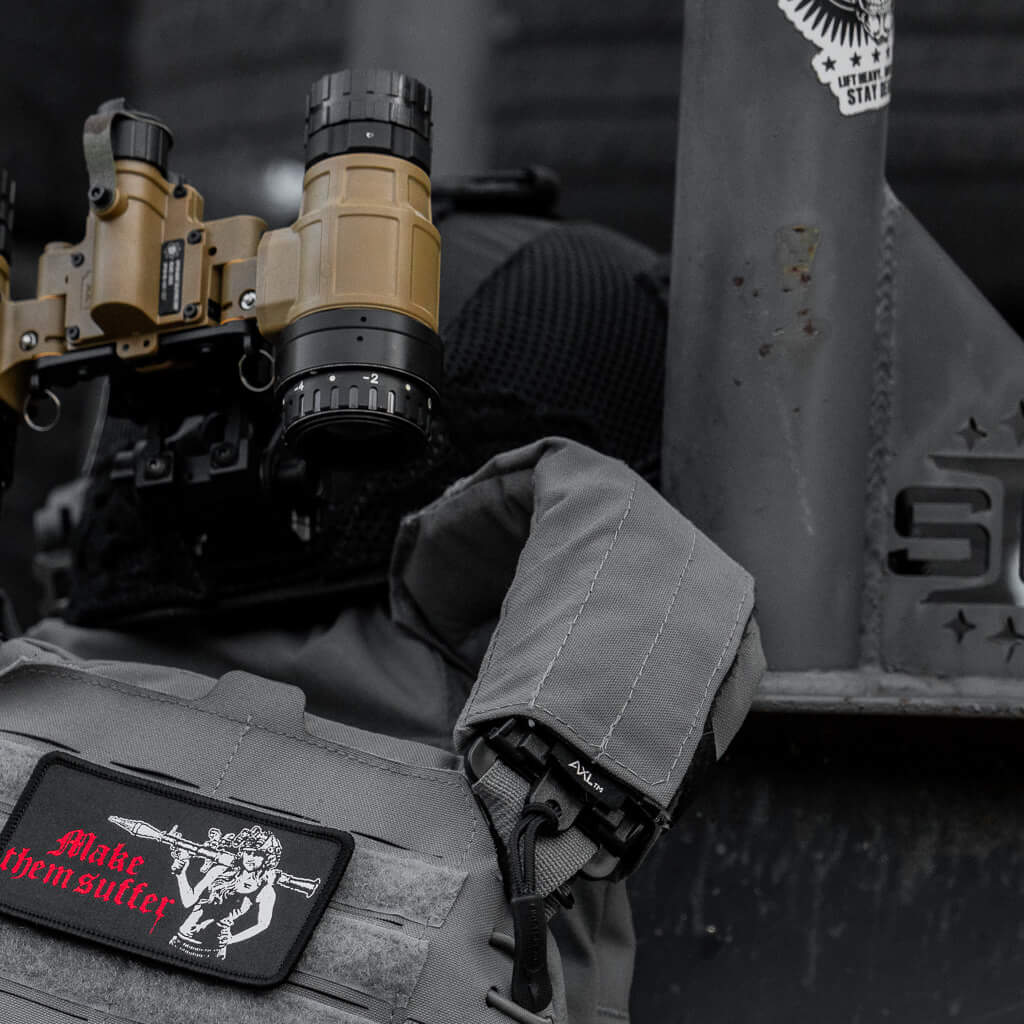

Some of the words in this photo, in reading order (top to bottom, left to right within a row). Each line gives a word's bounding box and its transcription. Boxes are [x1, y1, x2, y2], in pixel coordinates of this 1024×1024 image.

[847, 84, 877, 106] STAY
[362, 373, 379, 385] -2
[47, 829, 145, 876] Make
[0, 846, 75, 889] them
[74, 873, 176, 935] suffer
